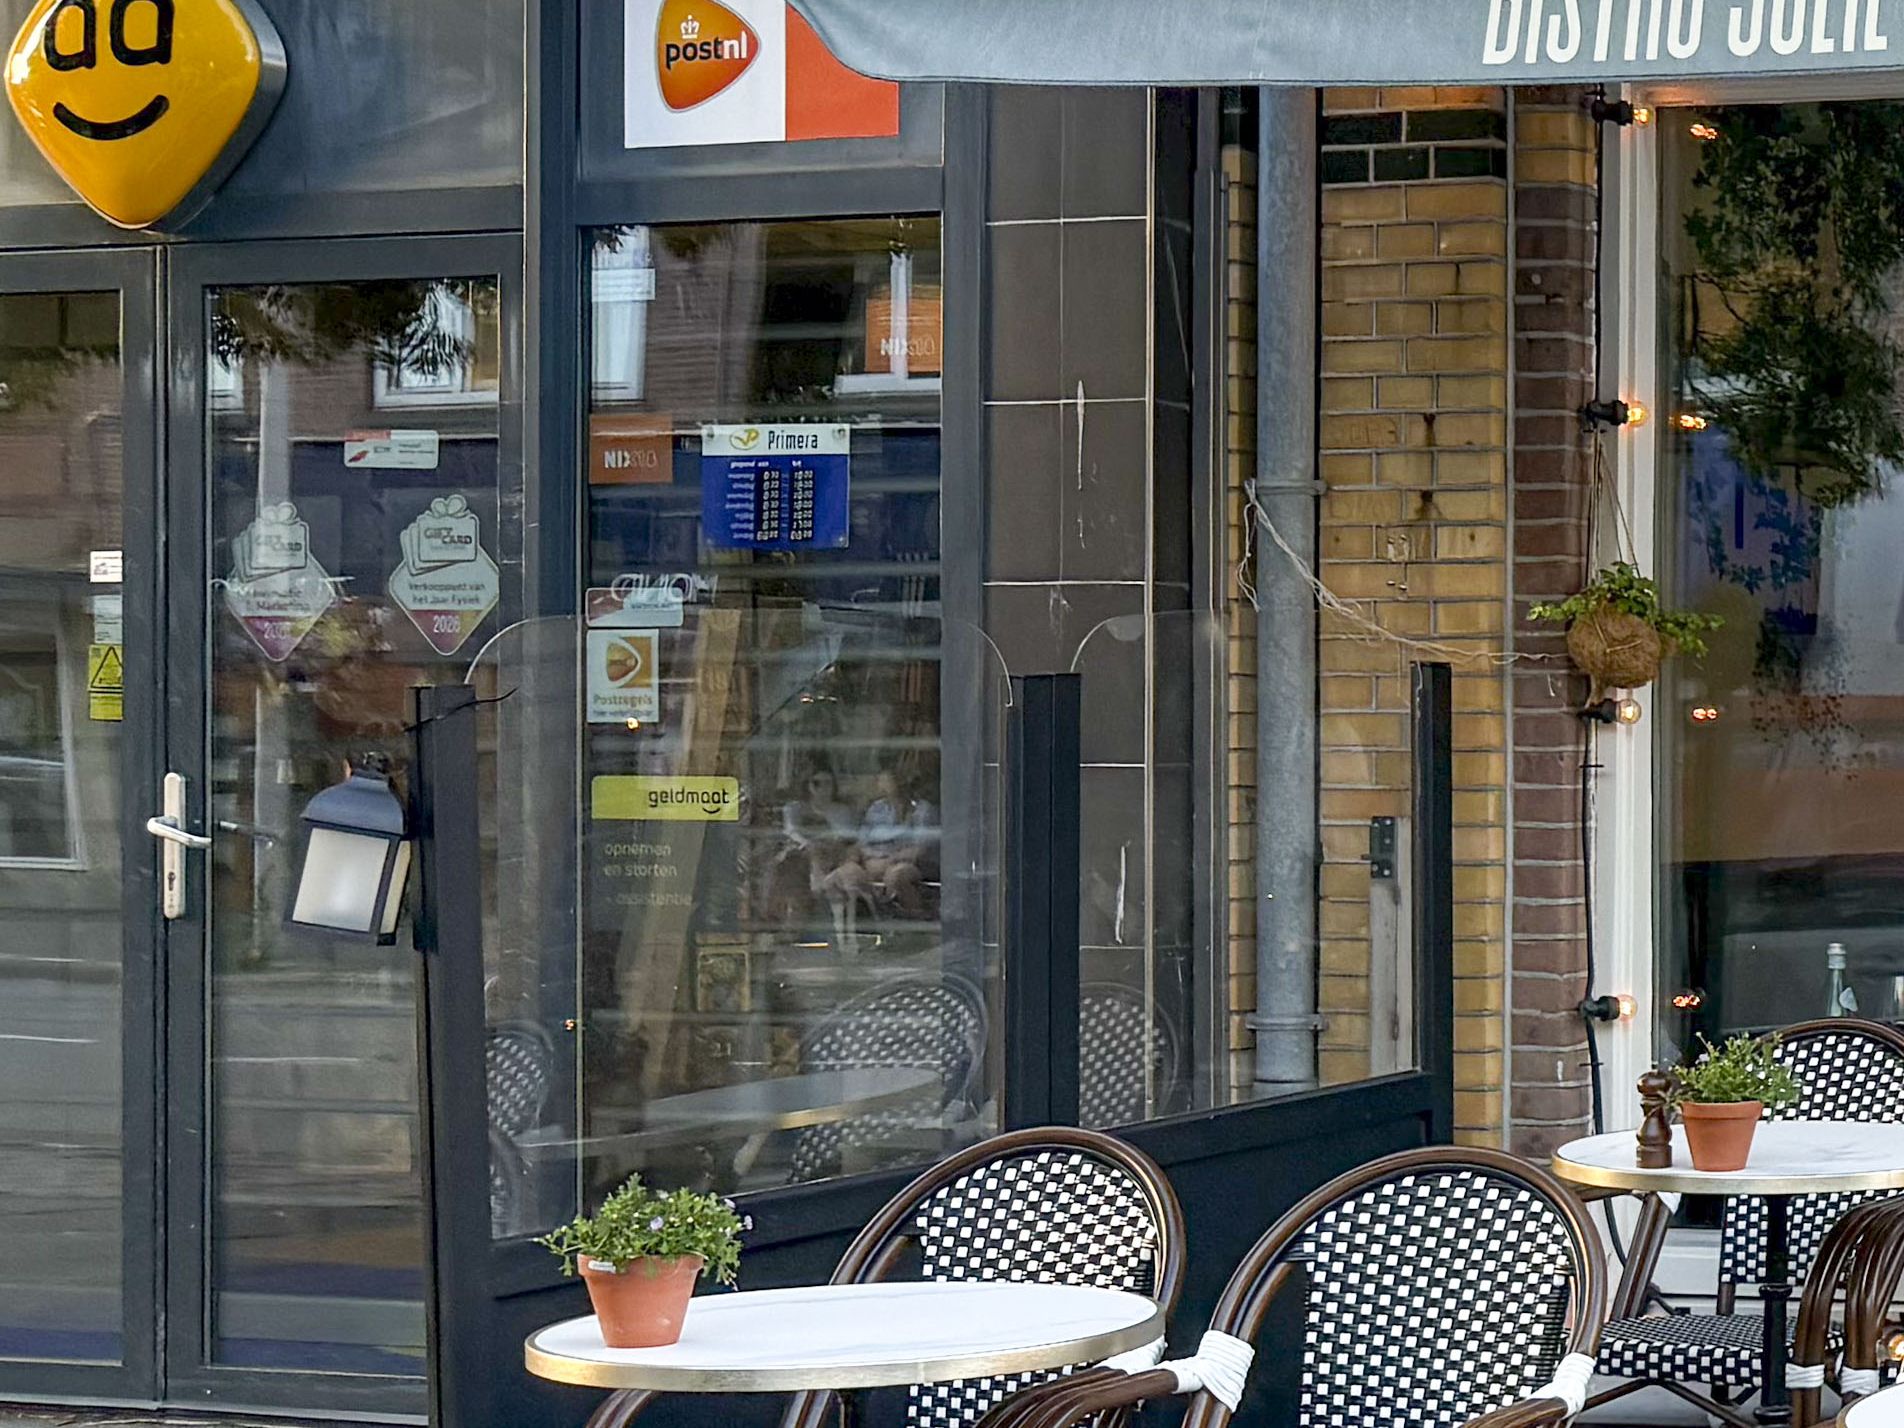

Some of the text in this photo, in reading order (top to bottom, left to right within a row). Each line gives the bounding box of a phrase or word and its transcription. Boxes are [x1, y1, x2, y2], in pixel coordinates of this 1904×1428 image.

[665, 30, 748, 71] postnl
[768, 430, 819, 451] Primera
[648, 786, 730, 808] geldmaat
[604, 842, 672, 857] opnemen
[625, 863, 678, 877] storten
